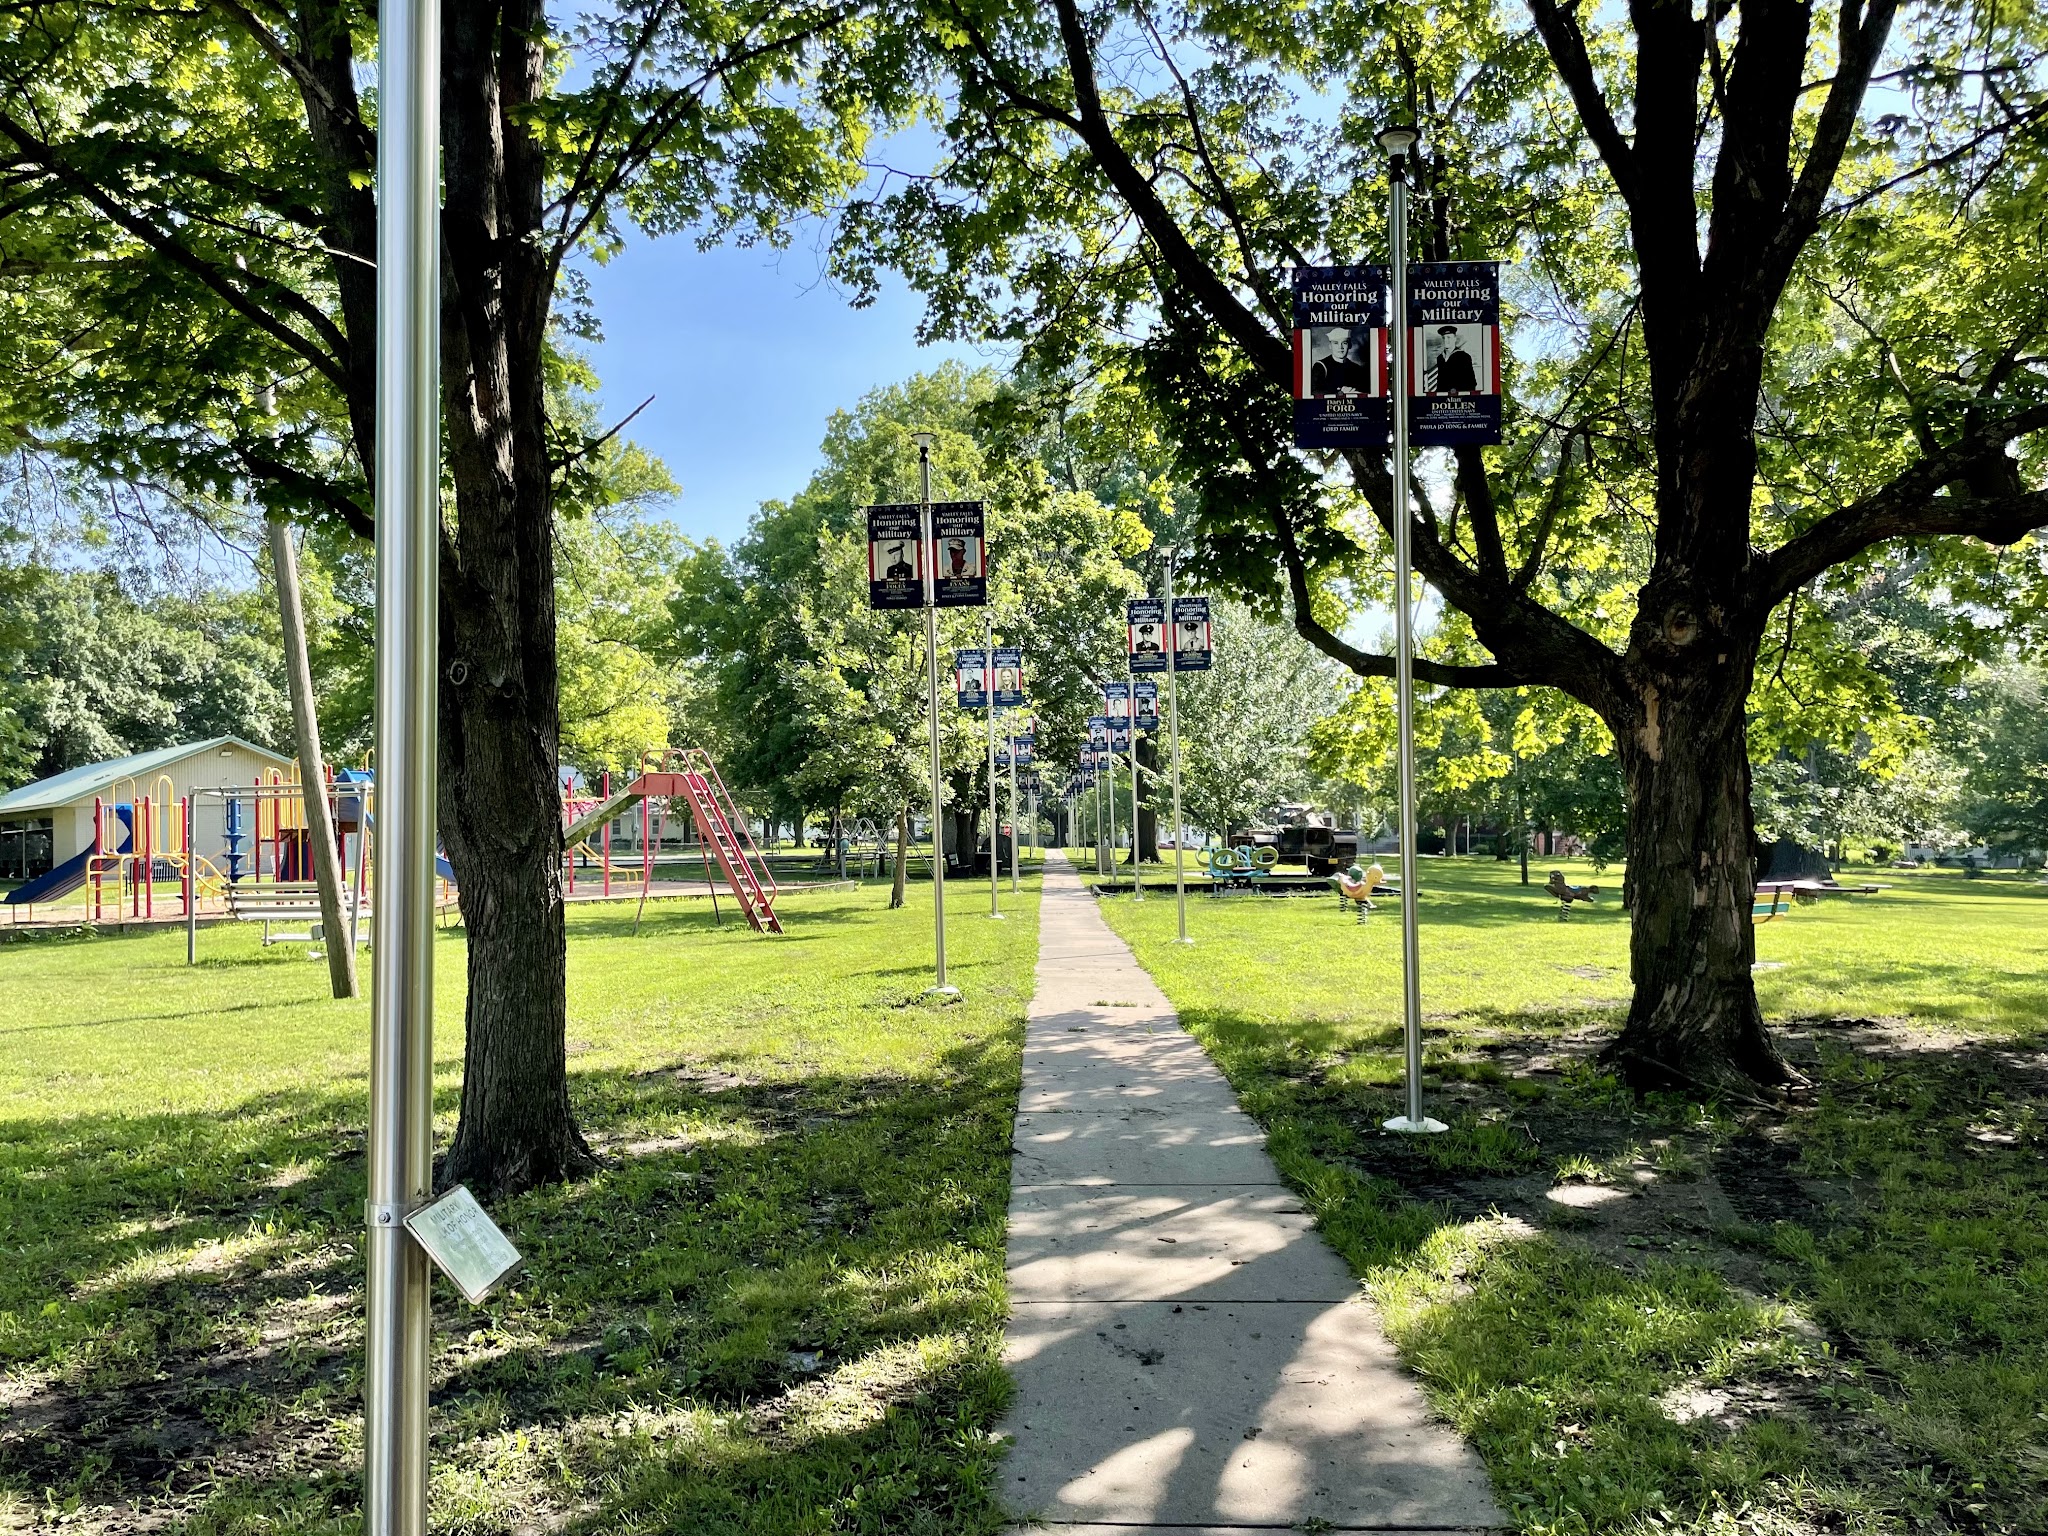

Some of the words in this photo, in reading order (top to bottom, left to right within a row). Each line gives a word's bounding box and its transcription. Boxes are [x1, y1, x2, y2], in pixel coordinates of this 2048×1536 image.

[1302, 290, 1378, 304] Honoring
[1414, 287, 1490, 300] Honoring
[1310, 311, 1370, 324] Military
[1422, 308, 1483, 322] Military
[1432, 402, 1476, 410] DOLLEN
[872, 519, 916, 527] Honoring
[936, 516, 979, 524] Honoring
[878, 530, 912, 538] Military
[941, 528, 975, 536] Military
[430, 1202, 460, 1223] MILITARY
[448, 1220, 458, 1233] OF
[457, 1206, 478, 1228] HONOR
